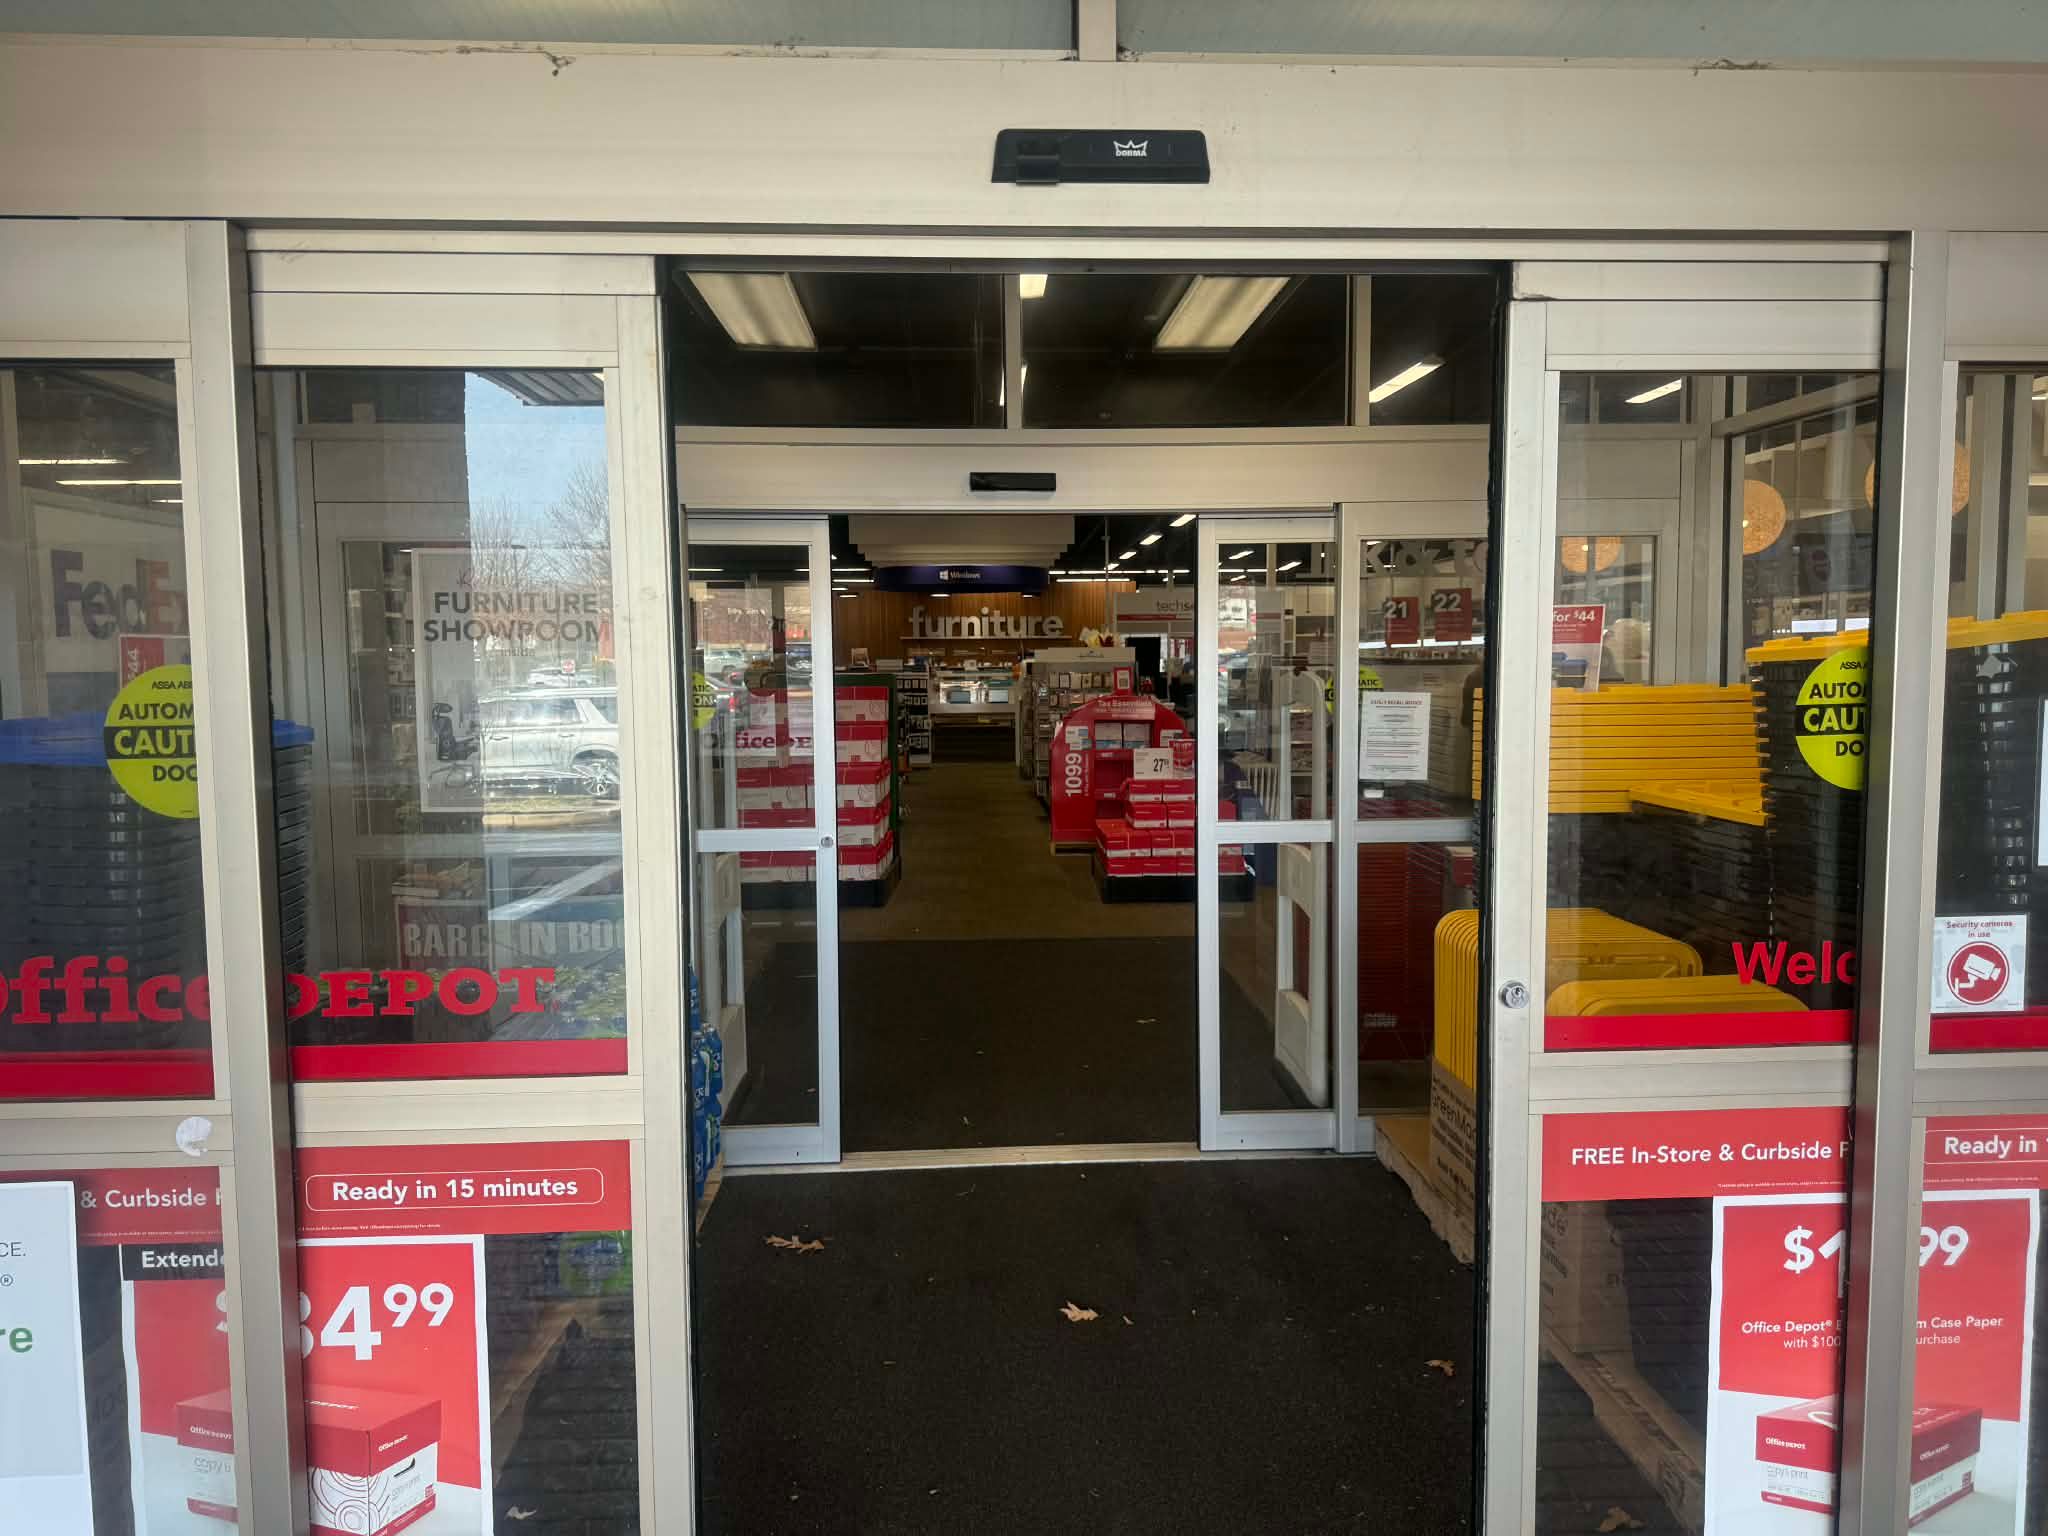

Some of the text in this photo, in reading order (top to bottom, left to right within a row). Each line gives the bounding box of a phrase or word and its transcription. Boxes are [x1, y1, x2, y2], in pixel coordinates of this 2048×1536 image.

[434, 590, 599, 614] FURNITURE
[1384, 600, 1408, 618] 21
[1434, 592, 1462, 612] 22
[907, 605, 1064, 638] furniture
[1810, 682, 1865, 699] AUTO
[1065, 752, 1082, 797] 1099
[1947, 921, 1979, 929] Security
[403, 922, 560, 958] BARGIN
[0, 956, 212, 1025] ffic
[1572, 1147, 1625, 1165] FREE
[1631, 1145, 1712, 1164] In-Store
[1719, 1143, 1735, 1162] &
[1741, 1141, 1833, 1162] Curbside
[1944, 1135, 2038, 1159] Ready in
[80, 1190, 97, 1209] &
[105, 1187, 207, 1209] Curbside
[333, 1176, 578, 1205] Ready in 15 minutes
[1742, 1320, 1781, 1335] Office
[1930, 1316, 1962, 1329] Case
[1965, 1314, 2005, 1330] Paper
[1783, 1336, 1809, 1349] with
